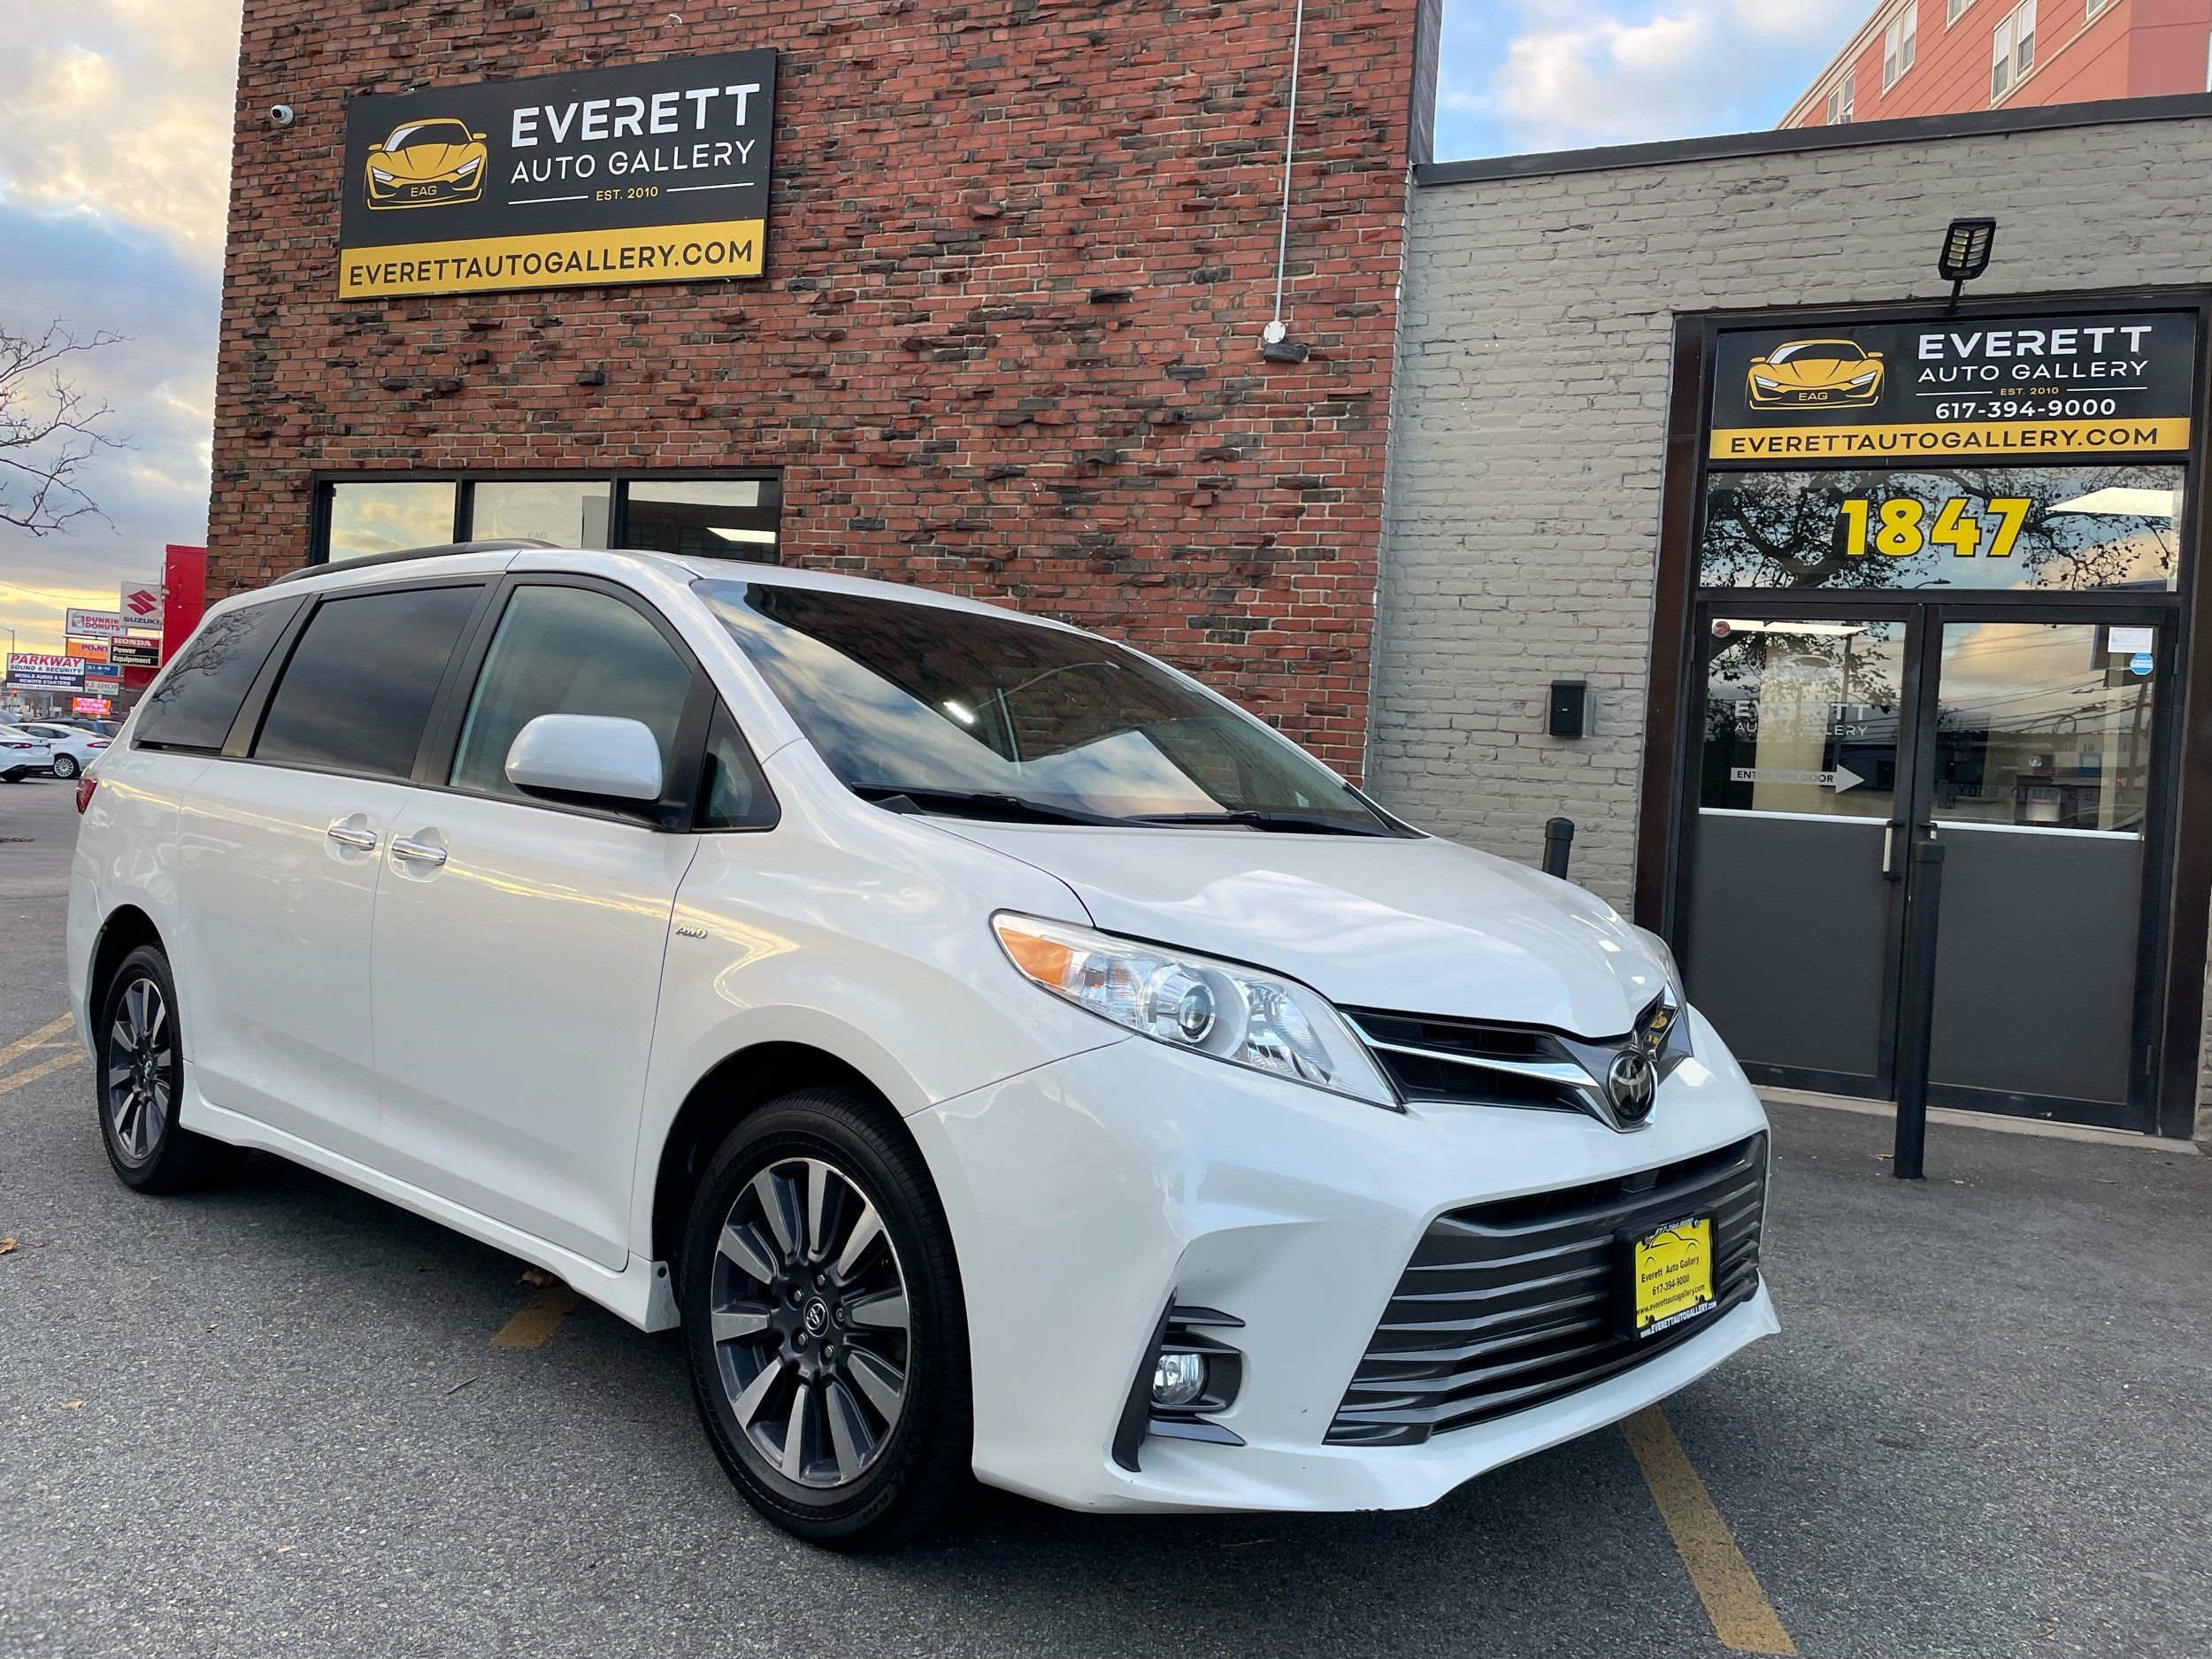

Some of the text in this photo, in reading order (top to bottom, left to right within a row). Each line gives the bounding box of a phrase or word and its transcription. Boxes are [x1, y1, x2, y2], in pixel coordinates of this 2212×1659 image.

[511, 83, 761, 148] EVERETT
[511, 139, 755, 184] AUTO GALLERY
[411, 186, 437, 196] EAG
[595, 186, 658, 202] EST. 2010
[349, 239, 753, 287] EVERETTAUTOGALLERY.COM
[1918, 326, 2152, 360] EVERETT
[1918, 360, 2148, 383] AUTO GALLERY
[1799, 391, 1829, 402] EAG
[1935, 398, 2116, 419] 617-394-9000
[1731, 426, 2158, 453] EVERETTAUTOGALLERY.COM
[1840, 497, 2032, 558] 1847
[85, 622, 120, 631] DONUTS
[123, 616, 159, 625] SUZUKI
[114, 638, 151, 647] HONDA
[11, 655, 81, 667] PARKWAY
[112, 655, 151, 664] Equipment
[97, 682, 119, 691] SHOP
[1801, 772, 1833, 783] DOOR
[675, 926, 709, 940] AWD
[1641, 1256, 1700, 1283] Everett Auto Gallery
[1652, 1273, 1690, 1295] 617-394-9000
[1636, 1284, 1705, 1317] www.everettautogallery.com
